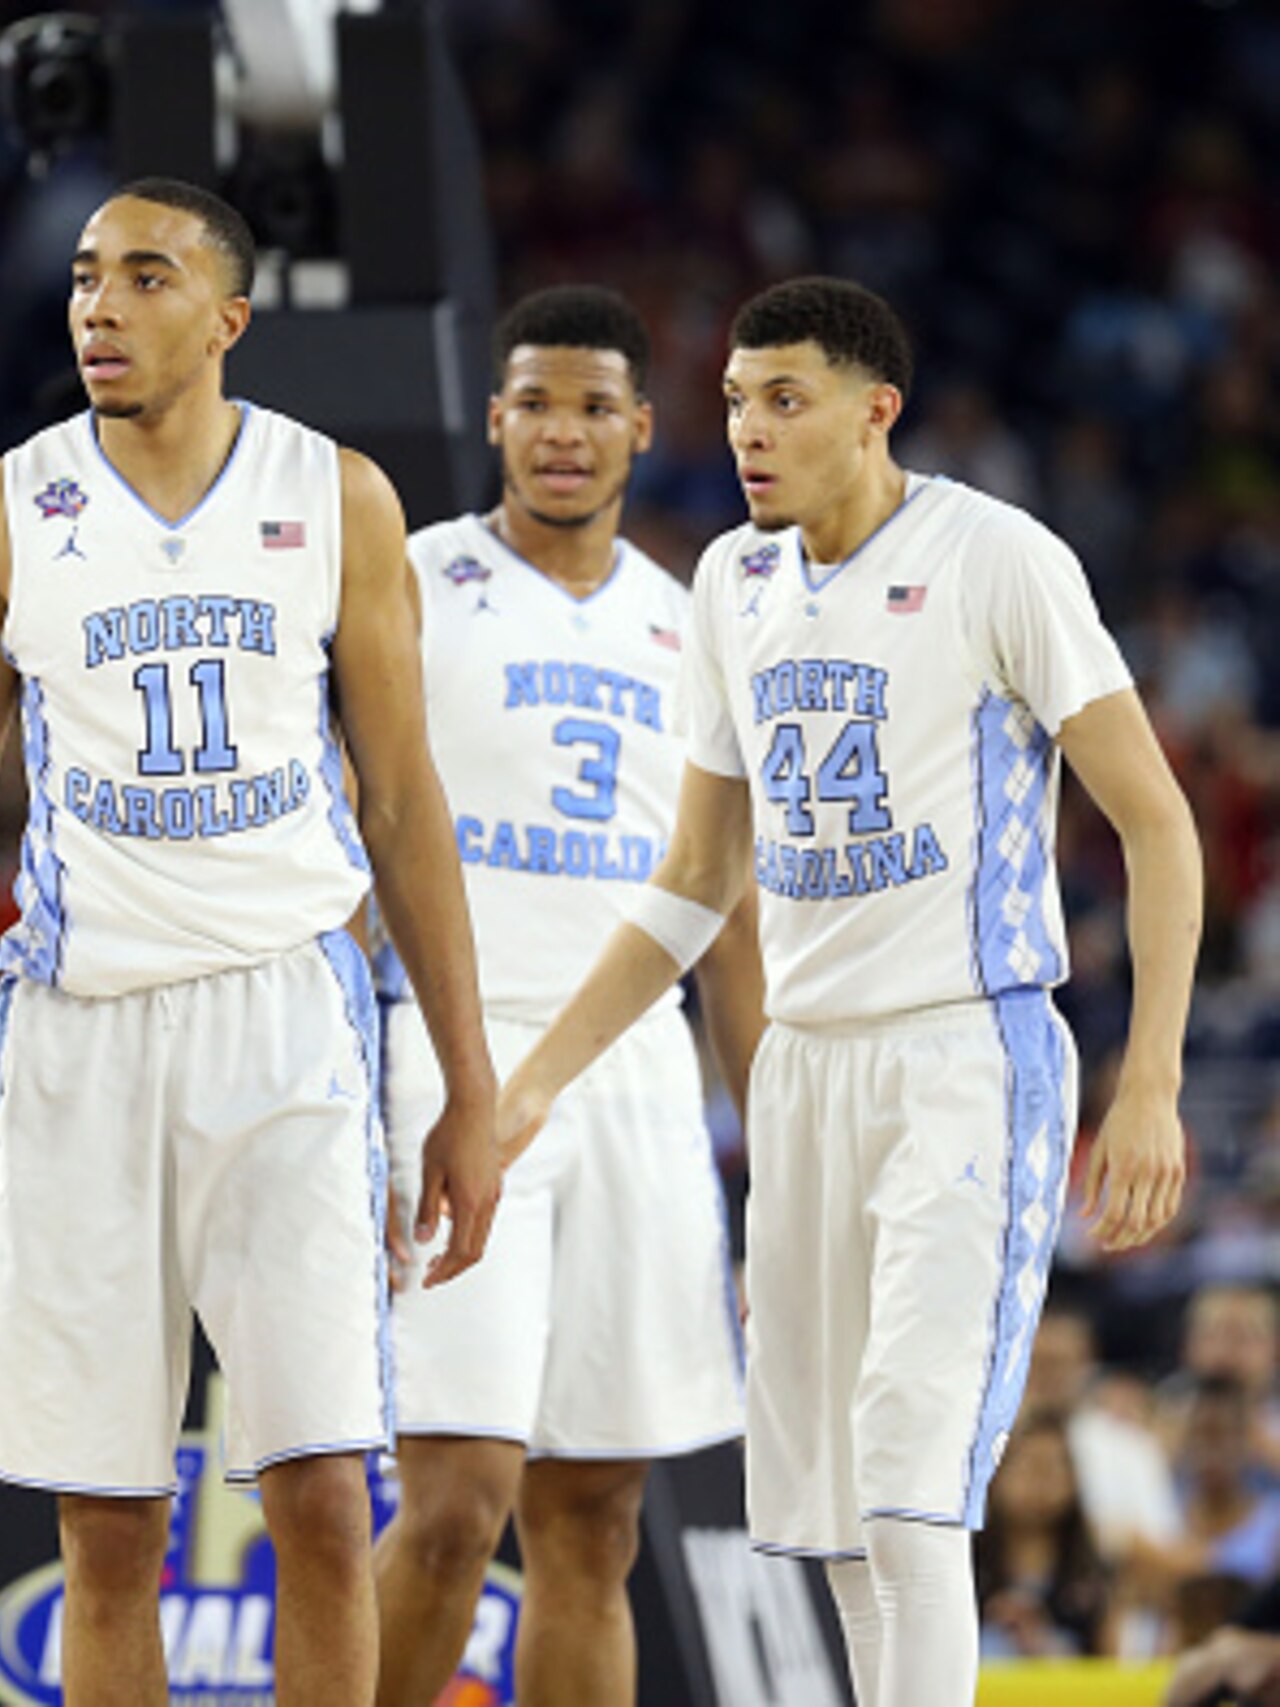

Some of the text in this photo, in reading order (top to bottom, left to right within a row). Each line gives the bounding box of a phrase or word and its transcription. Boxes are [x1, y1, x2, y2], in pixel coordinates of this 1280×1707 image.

[82, 596, 276, 668] NORTH
[133, 659, 238, 776] 11
[503, 660, 663, 733] NORTH
[750, 659, 889, 726] NORTH
[64, 759, 311, 841] CAROLINA
[551, 717, 622, 822] 3
[760, 719, 893, 837] 44
[754, 822, 949, 901] CAROLINA
